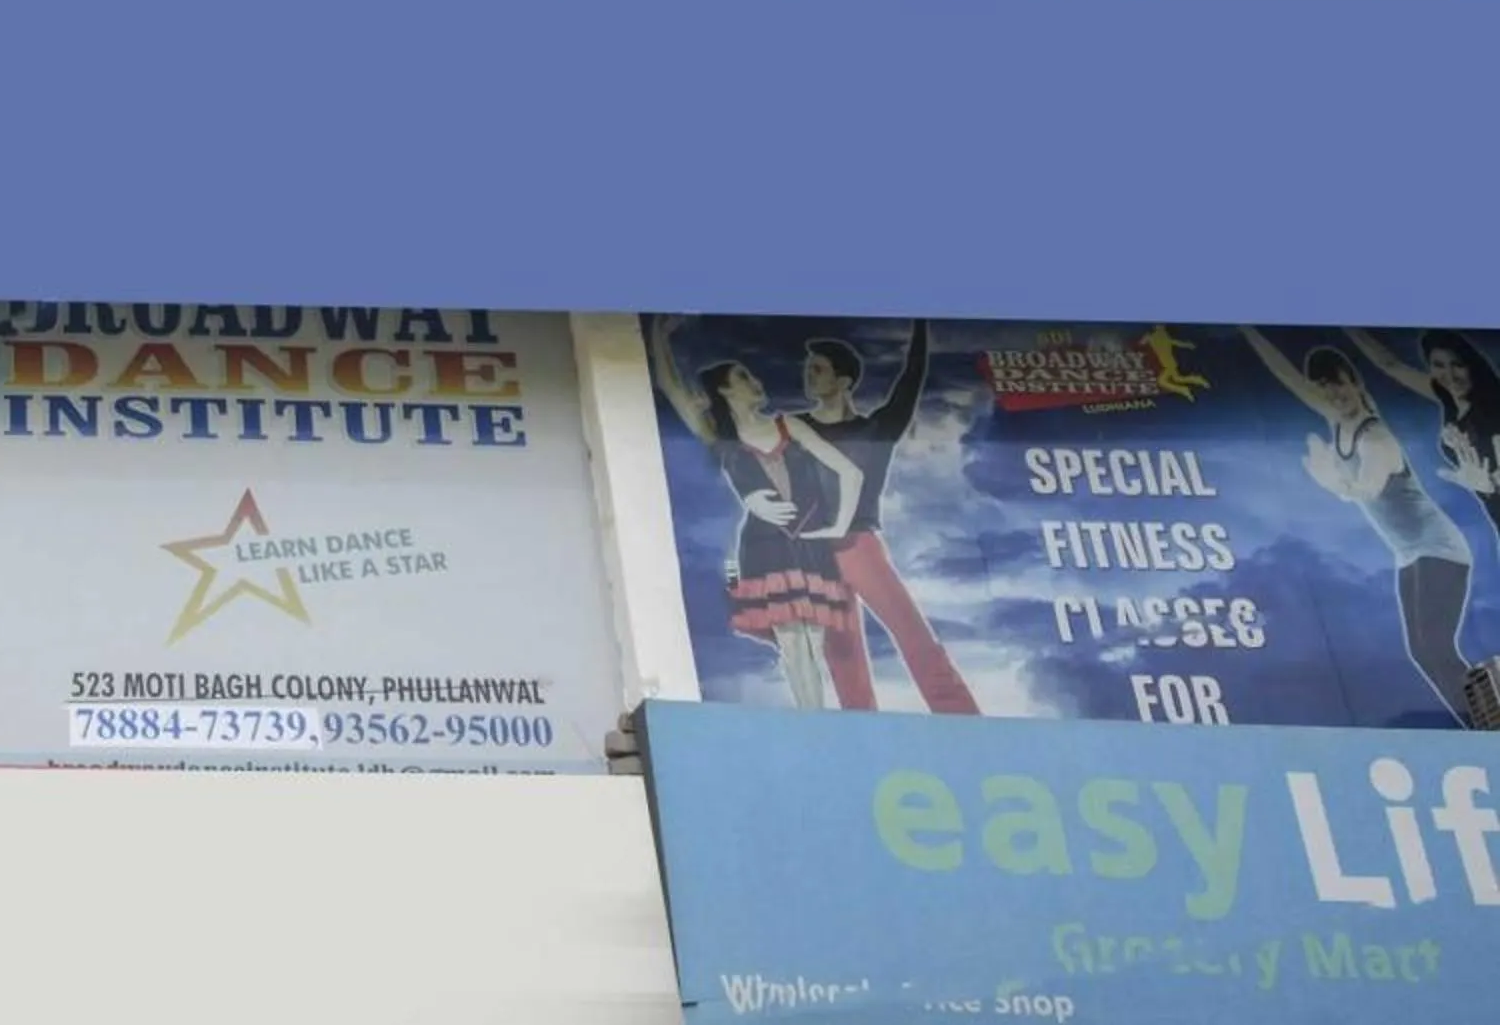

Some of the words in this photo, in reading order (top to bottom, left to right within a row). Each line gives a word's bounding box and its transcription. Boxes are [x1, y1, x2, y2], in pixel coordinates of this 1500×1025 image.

[2, 340, 521, 397] DANCE
[986, 350, 1144, 369] BROADWAY
[2, 394, 527, 447] INSTITUTE
[1025, 447, 1217, 497] SPECIAL
[235, 537, 318, 563] LEARN
[325, 528, 414, 553] DANCE
[297, 562, 353, 584] LIKE
[360, 558, 381, 579] A
[385, 552, 448, 576] STAR
[1041, 520, 1236, 571] FITNESS
[70, 672, 115, 698] 523
[123, 673, 185, 699] MOTI
[195, 673, 262, 699] BAGH
[271, 674, 375, 705] COLONY,
[383, 677, 546, 704] PHULLANWAL
[1130, 674, 1229, 725] FOR
[873, 768, 1249, 920] easy
[1302, 932, 1444, 983] Mart
